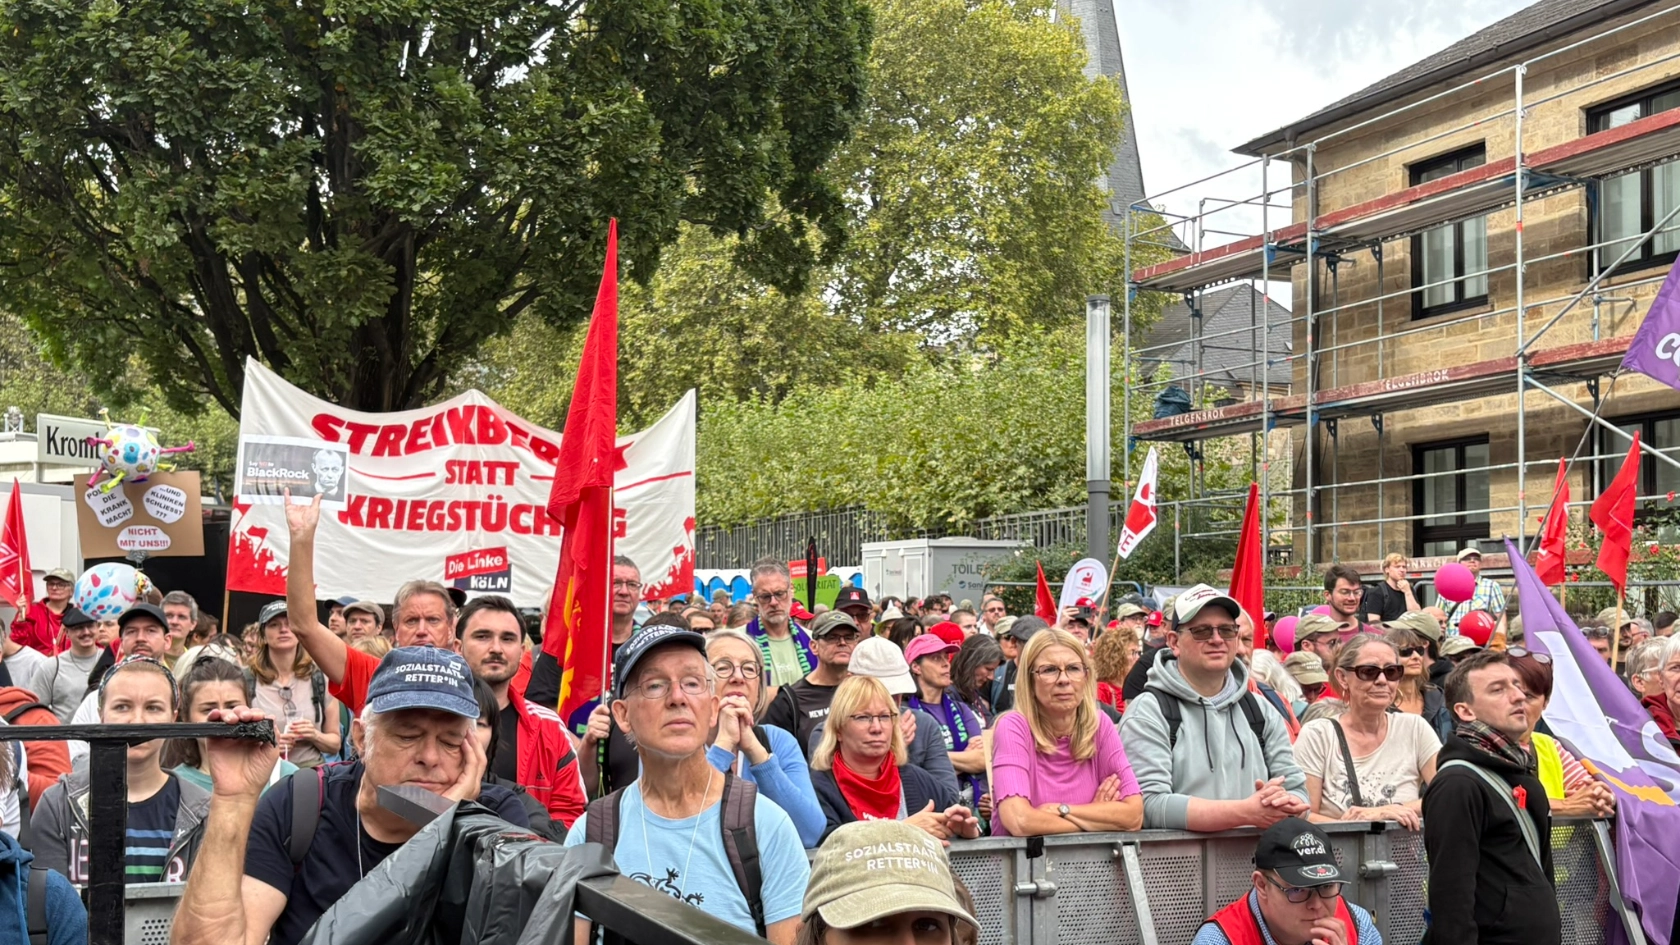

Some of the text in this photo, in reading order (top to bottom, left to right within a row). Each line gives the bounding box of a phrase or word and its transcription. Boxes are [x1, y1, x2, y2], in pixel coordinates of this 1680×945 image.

[246, 466, 310, 480] BlackRock
[445, 459, 520, 486] STATT
[102, 492, 117, 503] DIE
[150, 490, 184, 508] KLINIKEN
[99, 499, 128, 516] KRANK
[145, 497, 183, 516] SCHLIESST
[155, 510, 167, 519] ???
[105, 507, 132, 524] MACHT
[337, 493, 627, 538] KRIEGSTÜCHG
[127, 527, 158, 536] NICHT
[119, 539, 169, 548] MIT UNS!!!
[448, 552, 504, 575] Die Linke
[1296, 845, 1327, 856] ver.di
